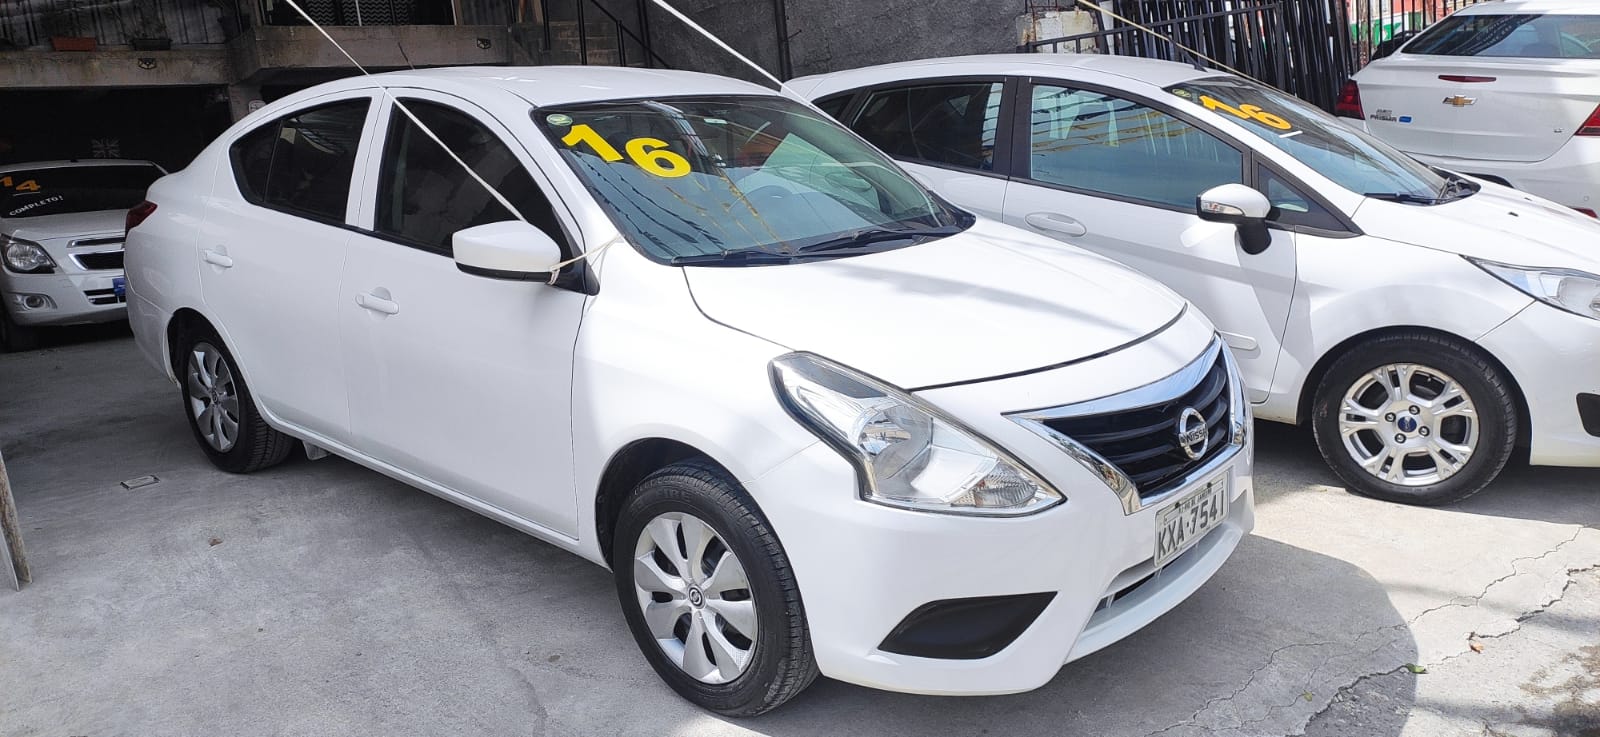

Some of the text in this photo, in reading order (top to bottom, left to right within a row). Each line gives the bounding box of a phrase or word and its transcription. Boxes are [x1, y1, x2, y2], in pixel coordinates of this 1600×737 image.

[1199, 95, 1292, 130] 16
[561, 123, 692, 178] 16
[0, 176, 40, 191] 14
[9, 195, 64, 216] COMPLETO!
